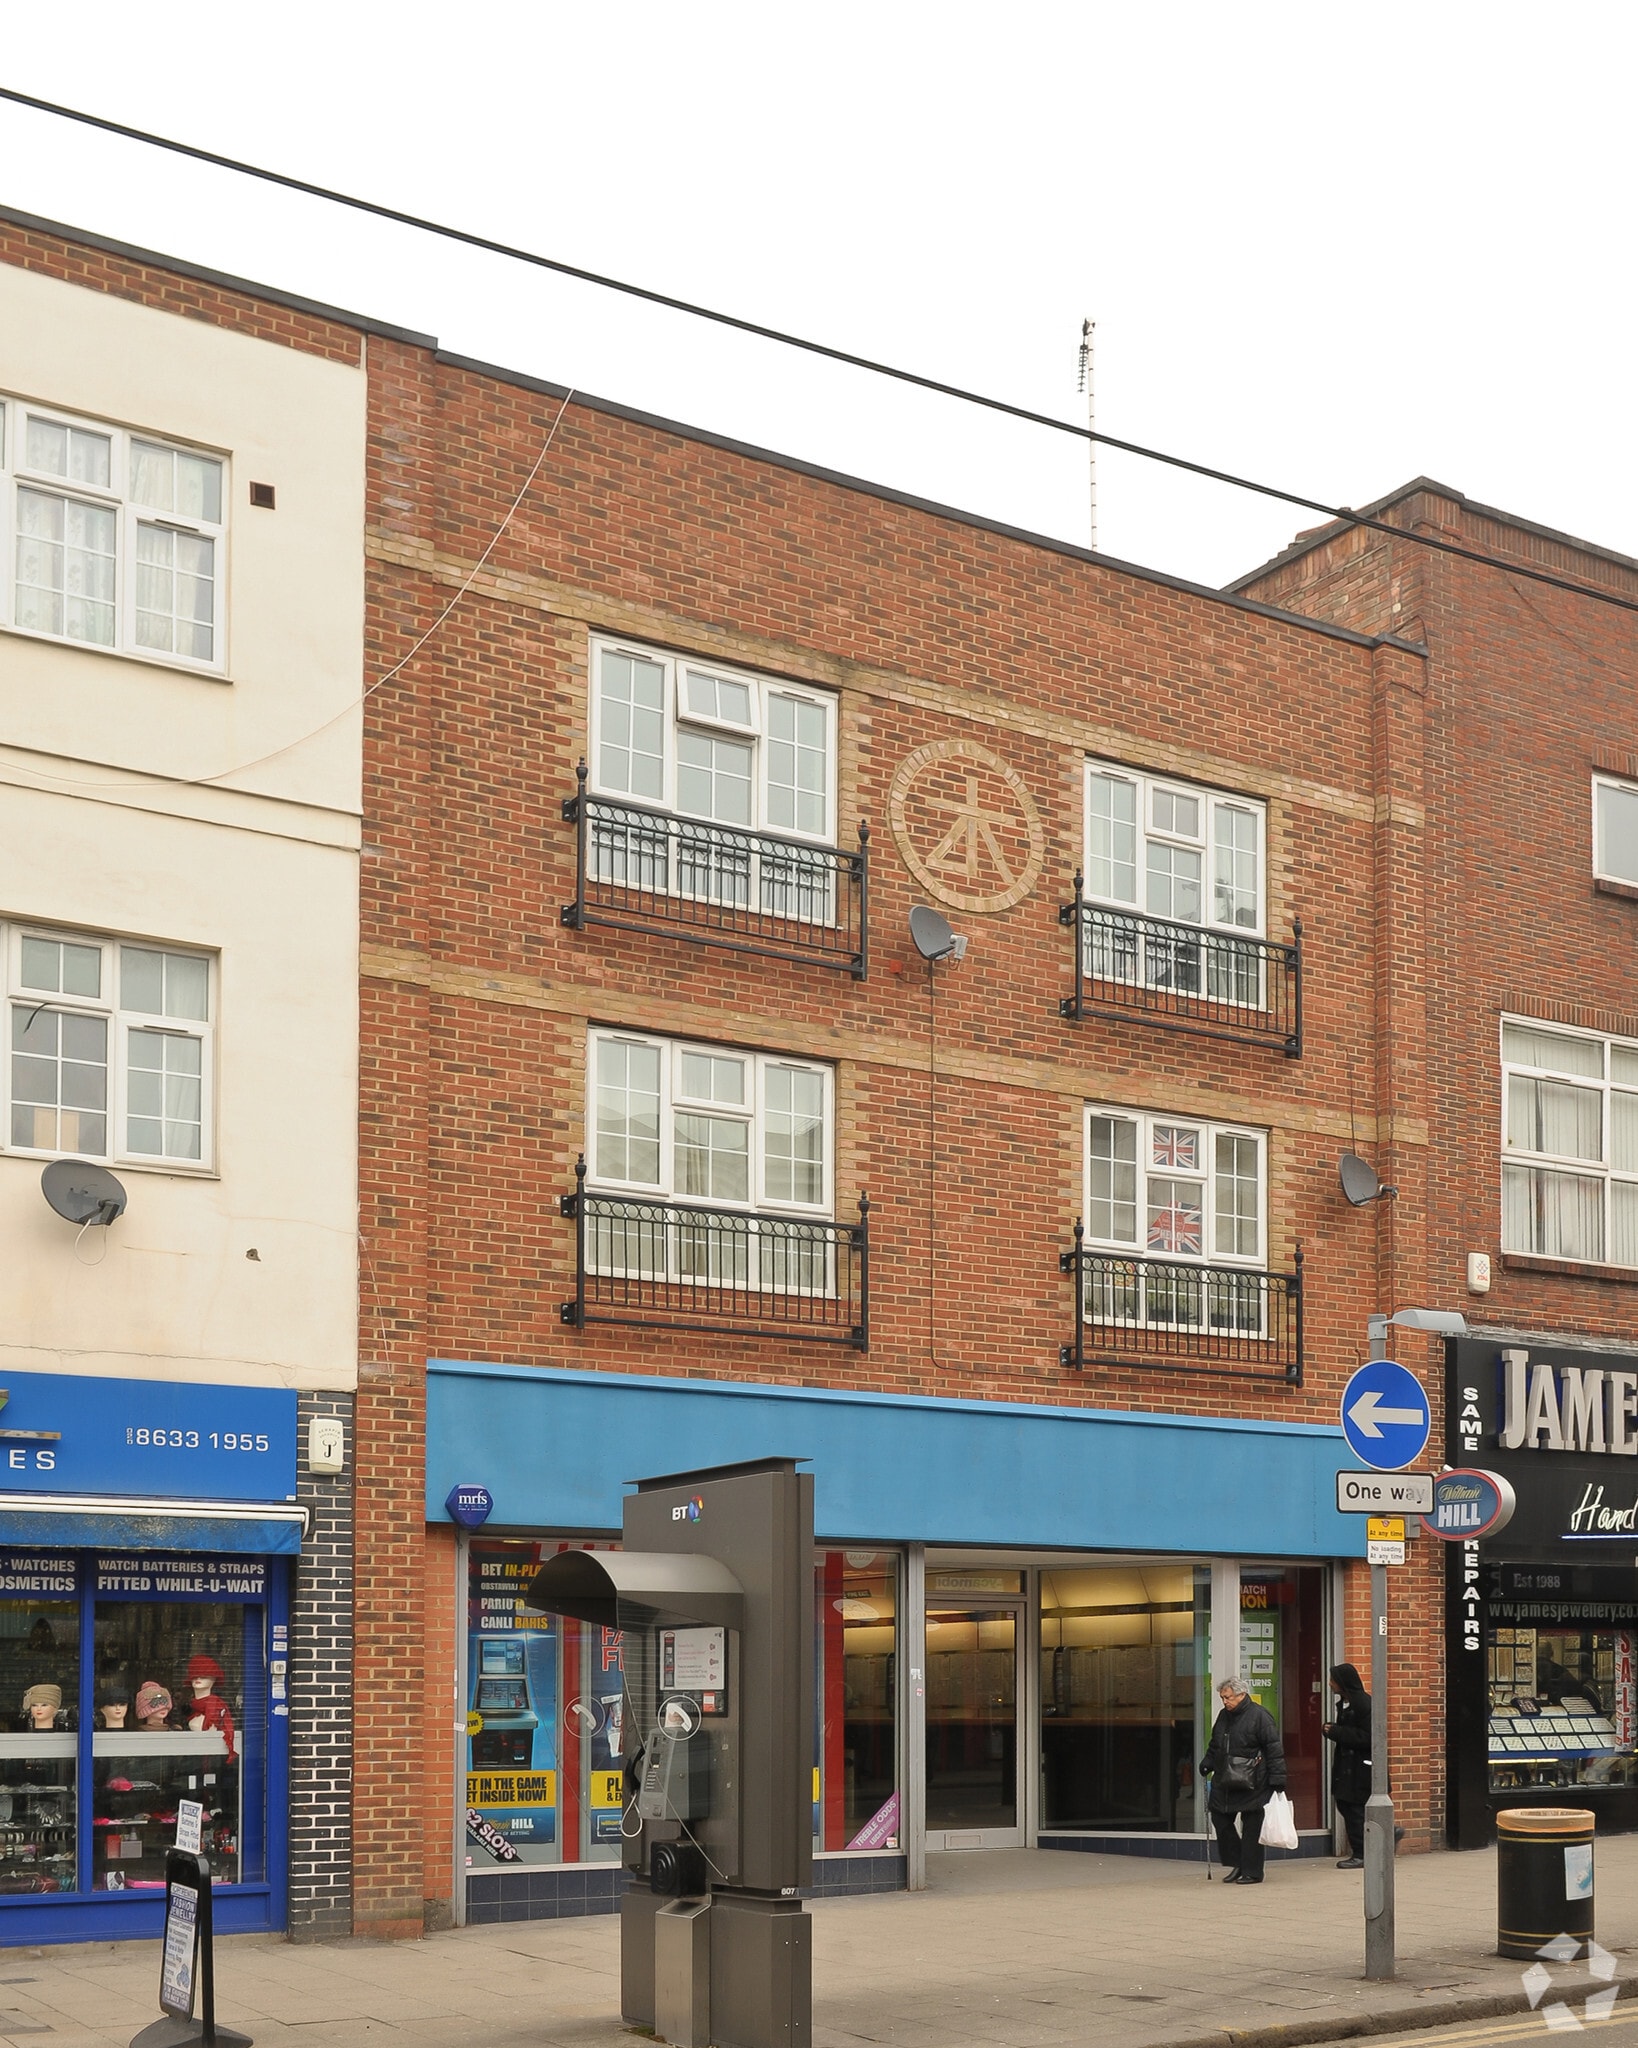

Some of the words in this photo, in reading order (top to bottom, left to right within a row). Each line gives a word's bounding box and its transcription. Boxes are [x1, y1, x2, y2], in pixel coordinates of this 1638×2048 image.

[1500, 1349, 1638, 1455] JAME
[1460, 1387, 1482, 1451] SAME
[136, 1428, 199, 1448] 8633
[209, 1432, 269, 1451] 1955
[9, 1449, 56, 1470] ES
[458, 1490, 488, 1505] mrfs
[1346, 1482, 1382, 1500] One
[1391, 1487, 1425, 1504] way
[1438, 1484, 1482, 1501] William
[672, 1505, 689, 1521] BT
[1437, 1503, 1481, 1527] HILL
[11, 1559, 76, 1573] WATCHES
[98, 1559, 139, 1571] WATCH
[142, 1561, 205, 1573] BATTERIES
[207, 1563, 217, 1574] &
[219, 1563, 265, 1575] STRAPS
[481, 1563, 502, 1576] BET
[98, 1576, 151, 1591] FITTED
[156, 1578, 265, 1593] WHILE-U-WAIT
[1513, 1573, 1533, 1588] Est
[1536, 1575, 1561, 1589] 1988
[1463, 1539, 1481, 1651] REPAIRS
[480, 1597, 514, 1610] PARIU
[480, 1616, 513, 1629] CANLI
[480, 1778, 492, 1790] IN
[494, 1778, 514, 1790] THE
[516, 1777, 547, 1789] GAME
[480, 1790, 516, 1803] INSIDE
[517, 1789, 547, 1801] NOW!
[511, 1818, 535, 1829] HILL
[855, 1821, 879, 1847] TREBLE
[876, 1799, 897, 1823] ODDS
[479, 1823, 516, 1860] SLOTS
